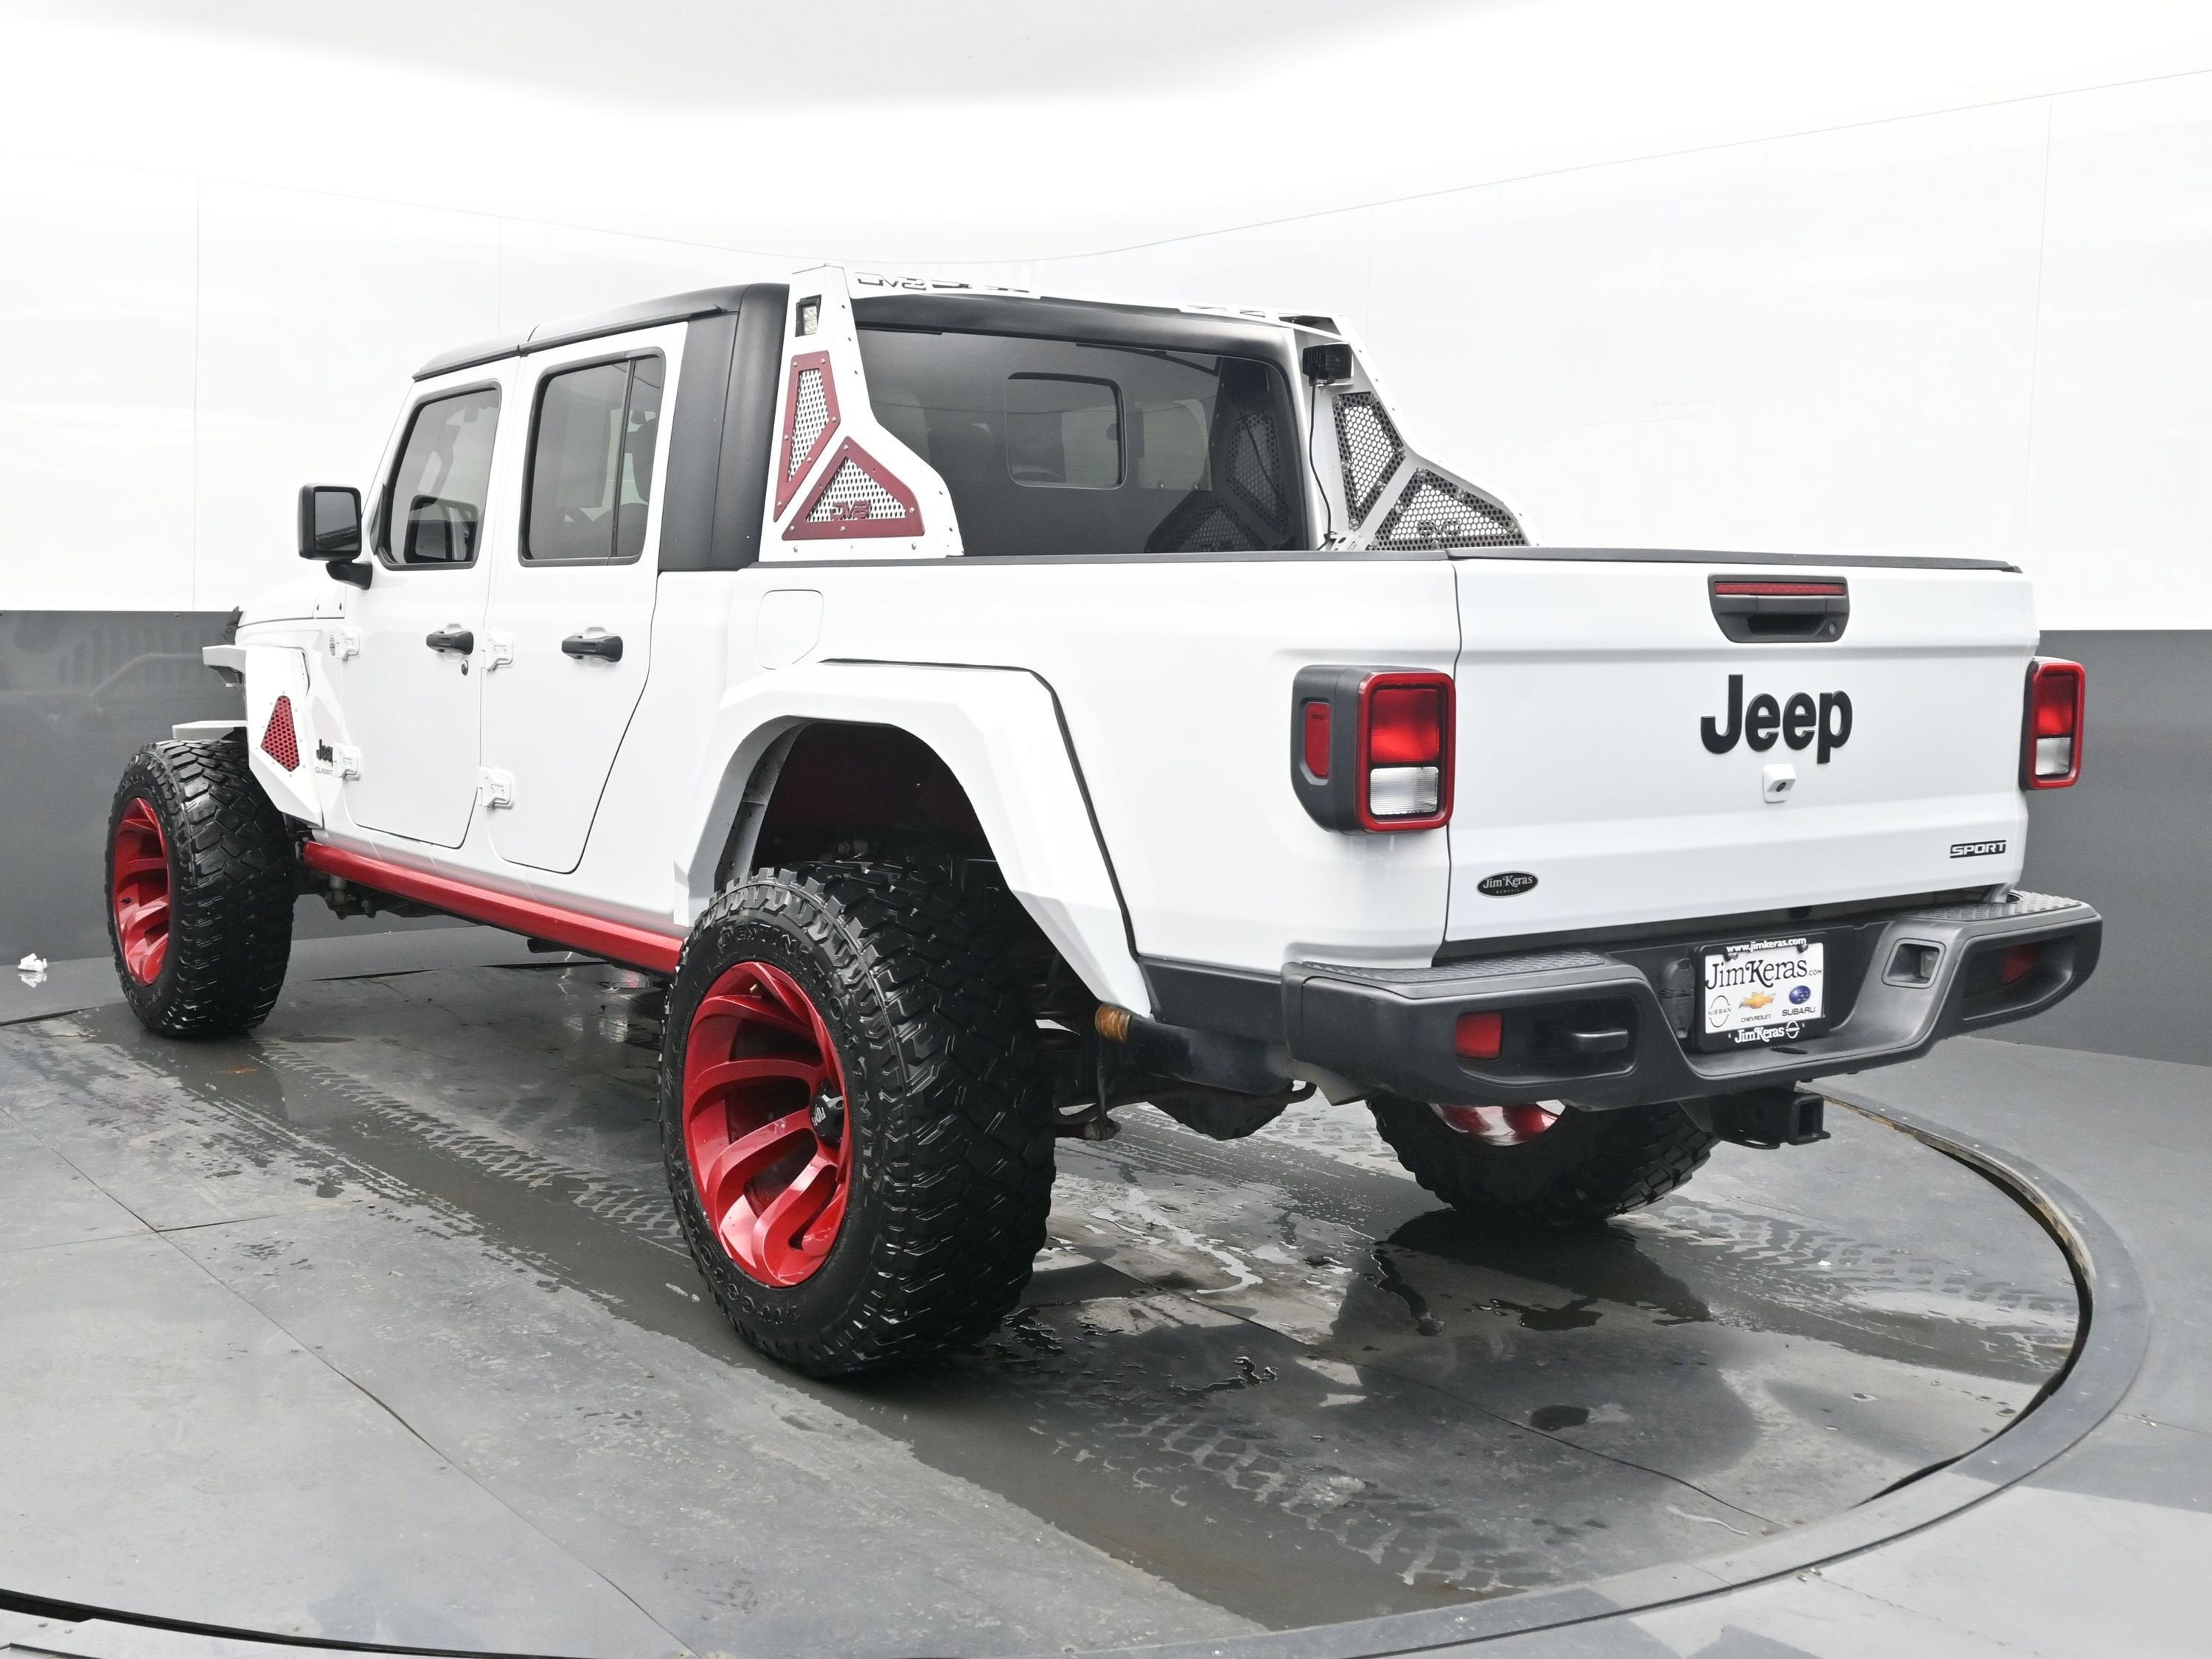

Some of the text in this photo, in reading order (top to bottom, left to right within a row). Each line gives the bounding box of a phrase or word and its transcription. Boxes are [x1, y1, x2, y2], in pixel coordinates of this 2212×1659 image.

[1700, 674, 1852, 764] Jeep
[1950, 841, 2006, 858] SPORT
[1726, 937, 1806, 953] www.jimkeras.com
[1708, 1007, 1732, 1015] NISSAN
[1782, 1006, 1816, 1017] SUBARU
[1741, 1014, 1772, 1023] CHEVROLET
